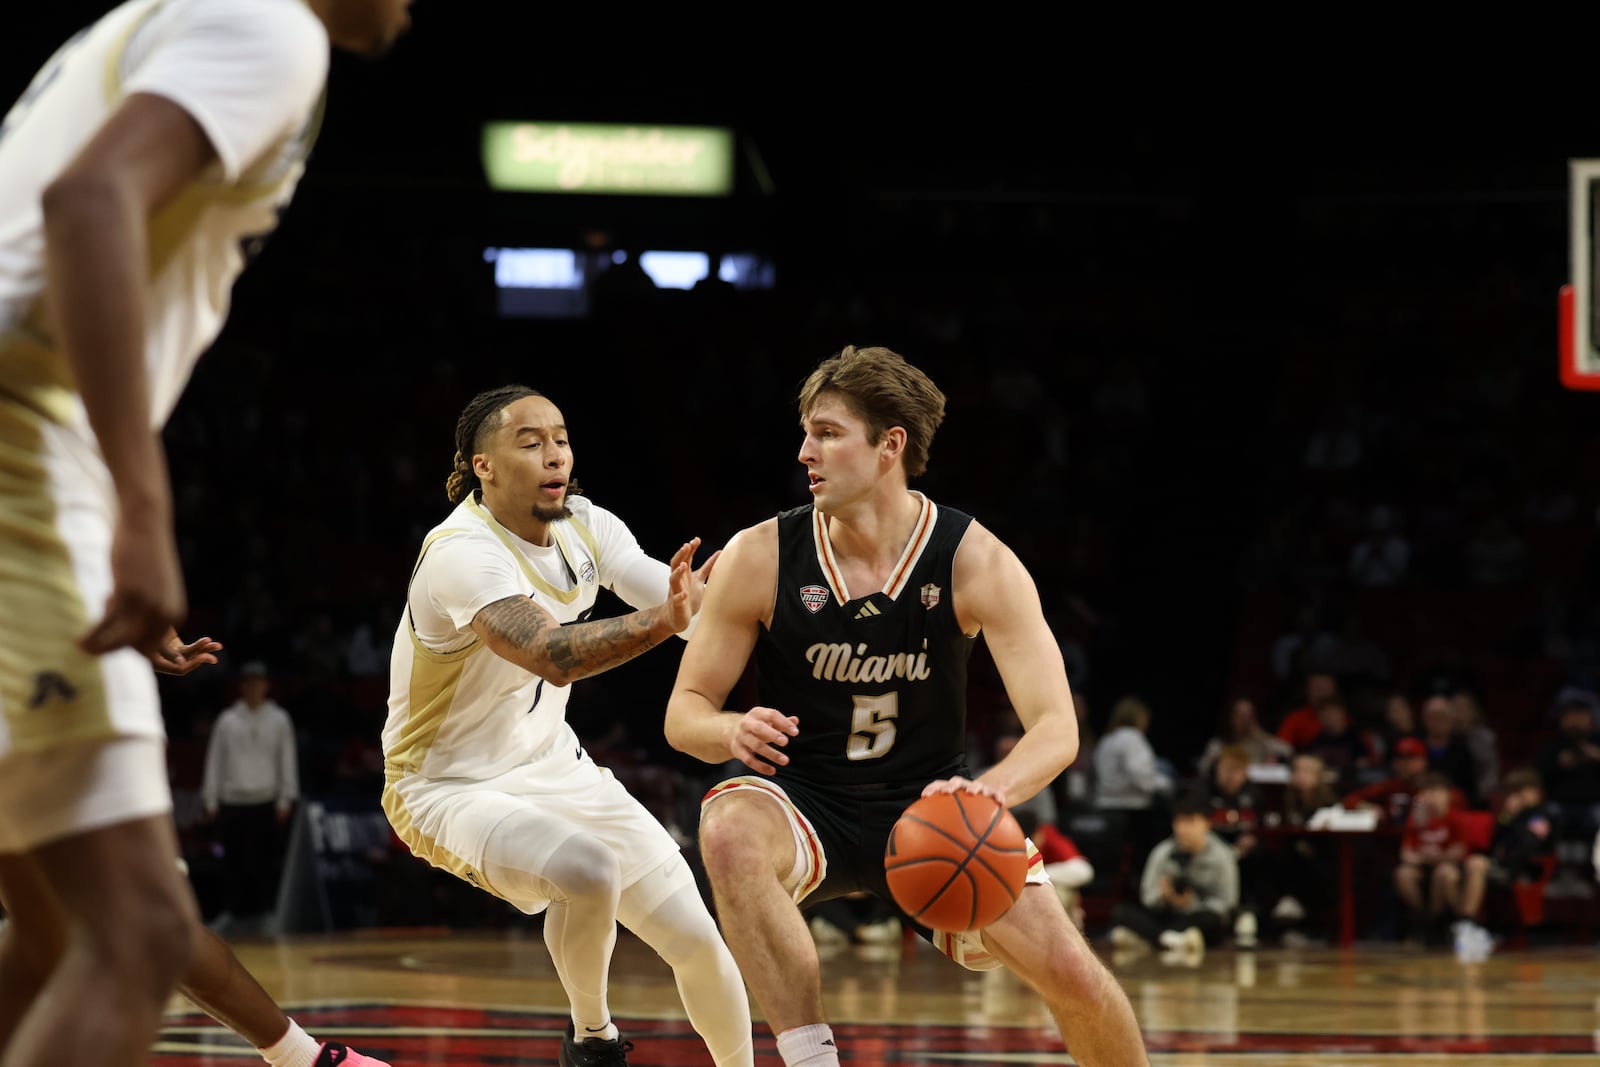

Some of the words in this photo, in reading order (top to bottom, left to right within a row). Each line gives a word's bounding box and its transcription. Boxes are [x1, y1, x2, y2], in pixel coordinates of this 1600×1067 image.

[802, 594, 827, 603] MAC
[804, 637, 931, 684] Miami
[846, 691, 899, 761] 5
